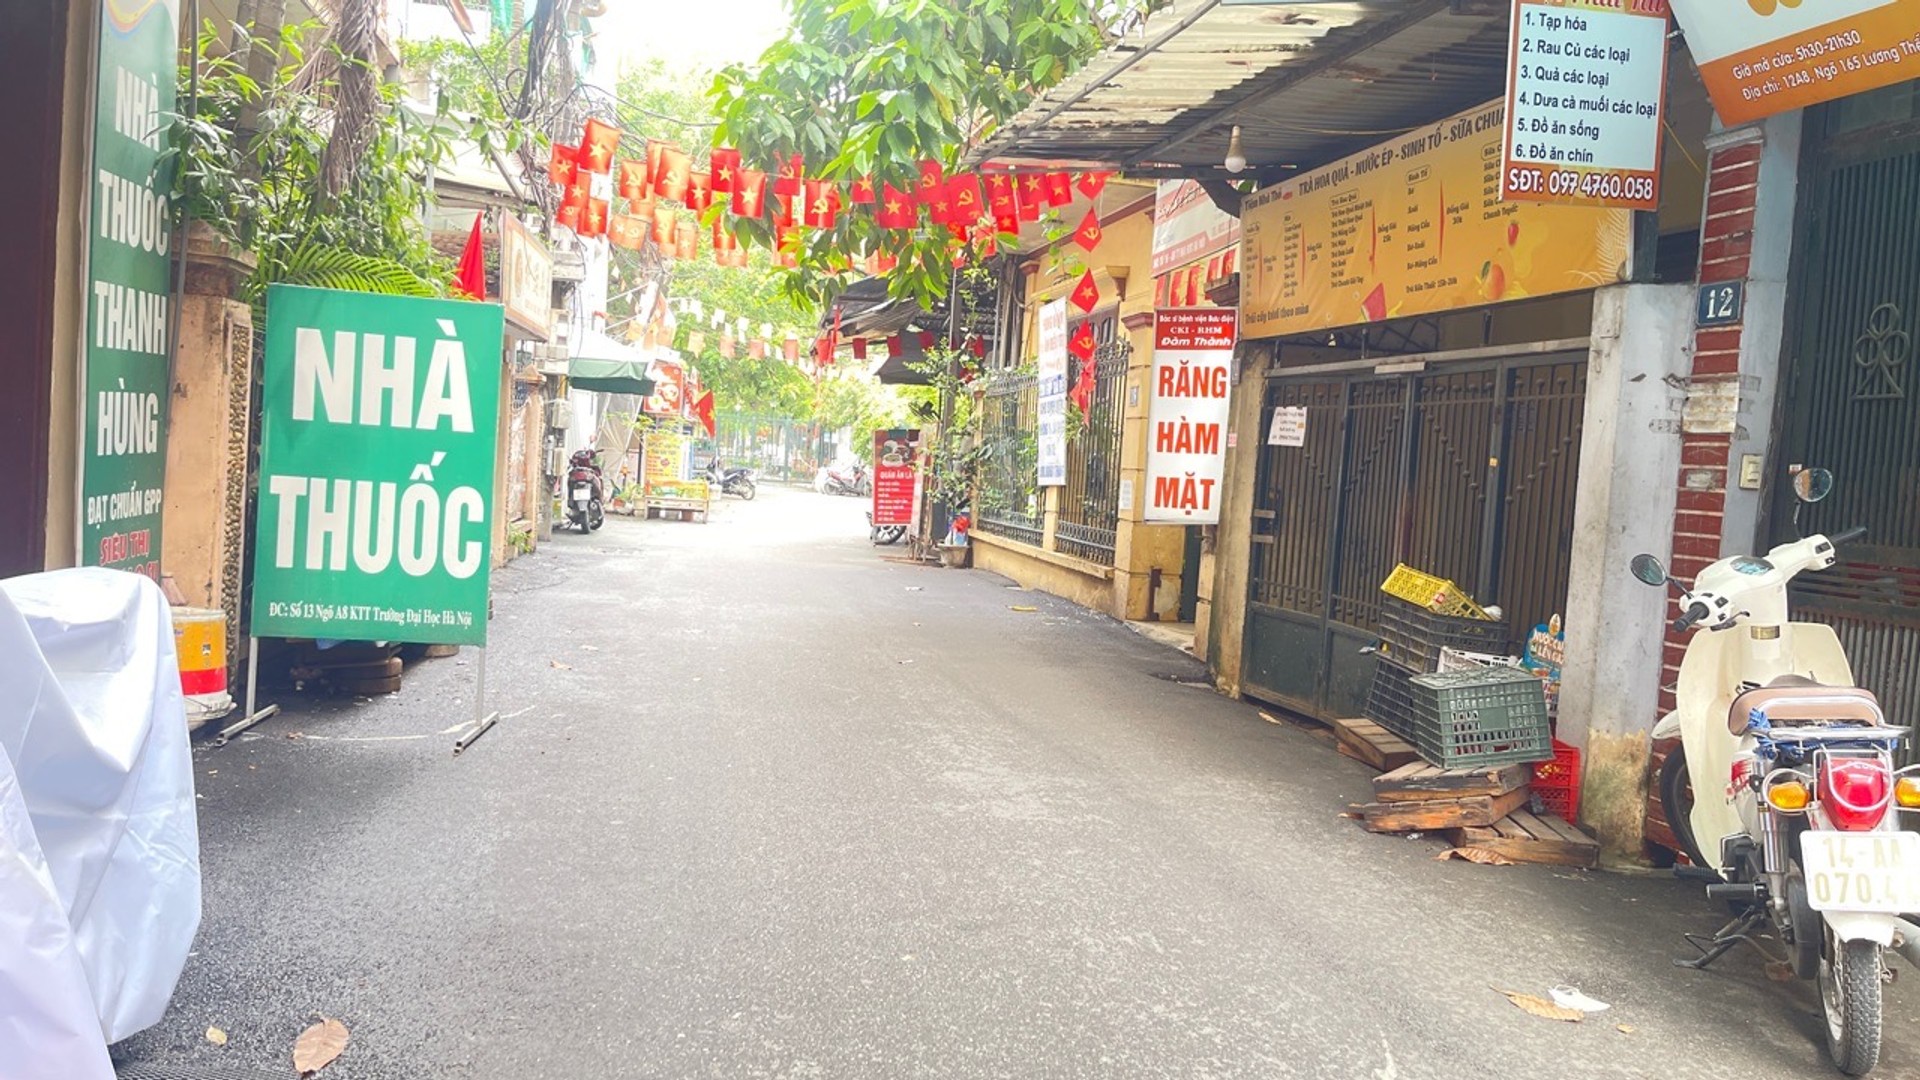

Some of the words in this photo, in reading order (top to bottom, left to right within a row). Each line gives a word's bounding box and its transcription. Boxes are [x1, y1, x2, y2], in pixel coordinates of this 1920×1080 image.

[1526, 13, 1534, 26] 1.
[1539, 13, 1561, 32] Tạp
[1564, 16, 1586, 31] hóa
[1522, 39, 1533, 53] 2.
[1538, 40, 1561, 55] Rau
[1564, 41, 1581, 58] Củ
[1584, 45, 1604, 60] các
[1608, 47, 1630, 64] loại
[1754, 57, 1770, 72] mở
[1814, 62, 1838, 80] Ngõ
[1840, 55, 1862, 72] 165
[1863, 46, 1900, 67] Lương
[1521, 65, 1532, 79] 3.
[1536, 66, 1560, 82] Quả
[1563, 70, 1584, 84] các
[1588, 72, 1609, 89] loại
[115, 65, 160, 153] NHÀ
[1519, 92, 1530, 104] 4.
[1534, 93, 1558, 108] Dưa
[1580, 95, 1609, 112] muối
[1612, 100, 1632, 114] các
[1636, 102, 1657, 119] loại
[1518, 118, 1528, 132] 5.
[1532, 116, 1548, 133] Đồ
[1552, 120, 1566, 134] ăn
[1569, 120, 1600, 141] sống
[1298, 176, 1314, 196] TRÀ
[1314, 172, 1330, 191] HOA
[1331, 161, 1350, 188] QUẢ
[1356, 153, 1380, 176] NƯỚC
[1381, 146, 1394, 168] ÉP
[1400, 138, 1426, 161] SINH
[1428, 122, 1444, 149] TỐ
[1450, 118, 1474, 143] SỮA
[1516, 144, 1526, 158] 6.
[1530, 142, 1546, 158] Đồ
[1550, 146, 1564, 160] ăn
[1568, 148, 1594, 162] chín
[1508, 168, 1544, 193] SĐT:
[1550, 171, 1579, 195] 097
[1581, 174, 1653, 200] 4760.058
[99, 168, 170, 257] THUỐC
[94, 280, 168, 356] THANH
[1706, 287, 1734, 319] 12
[1161, 336, 1190, 346] Đàm
[1194, 336, 1231, 346] Thành
[1170, 326, 1189, 334] CKI
[1198, 326, 1222, 334] RHM
[292, 318, 474, 434] NHÀ
[1158, 360, 1227, 398] RĂNG
[96, 377, 158, 457] HÙNG
[1156, 416, 1219, 455] HÀM
[88, 494, 109, 530] ĐẠT
[110, 481, 143, 519] CHUẨN
[144, 488, 162, 515] GPP
[1154, 471, 1215, 515] MẶT
[270, 451, 485, 580] THUỐC
[100, 532, 127, 566] SIÊU
[130, 528, 150, 560] THỊ
[269, 602, 288, 617] ĐC:
[290, 600, 303, 618] Số
[303, 604, 314, 618] 13
[316, 604, 334, 623] Ngõ
[334, 605, 348, 620] A8
[349, 606, 371, 620] KTT
[373, 606, 404, 626] Trường
[406, 608, 421, 627] Đại
[423, 608, 440, 628] Học
[442, 610, 455, 625] Hà
[456, 610, 472, 630] Nội
